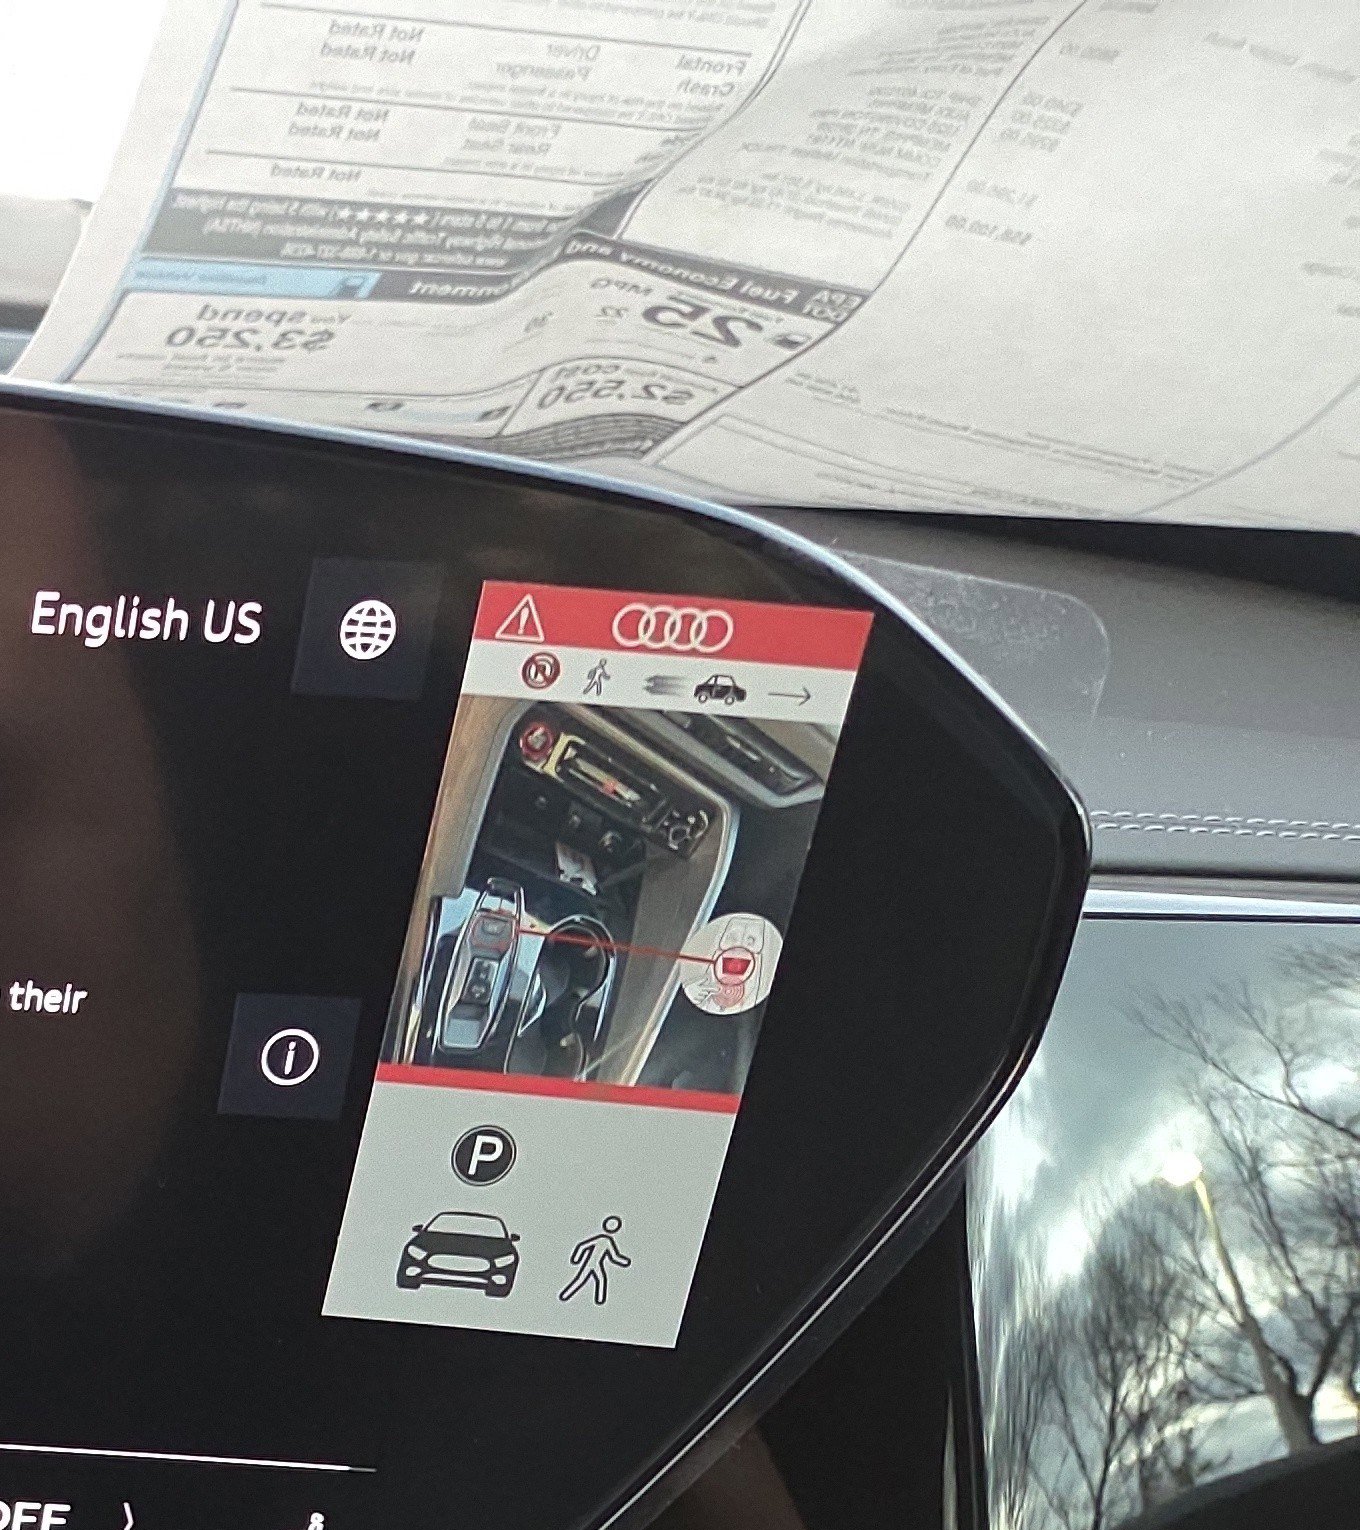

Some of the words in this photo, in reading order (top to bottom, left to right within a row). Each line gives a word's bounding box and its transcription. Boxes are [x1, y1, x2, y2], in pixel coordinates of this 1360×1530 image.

[31, 590, 189, 648] English
[203, 599, 262, 644] US
[9, 979, 88, 1014] their
